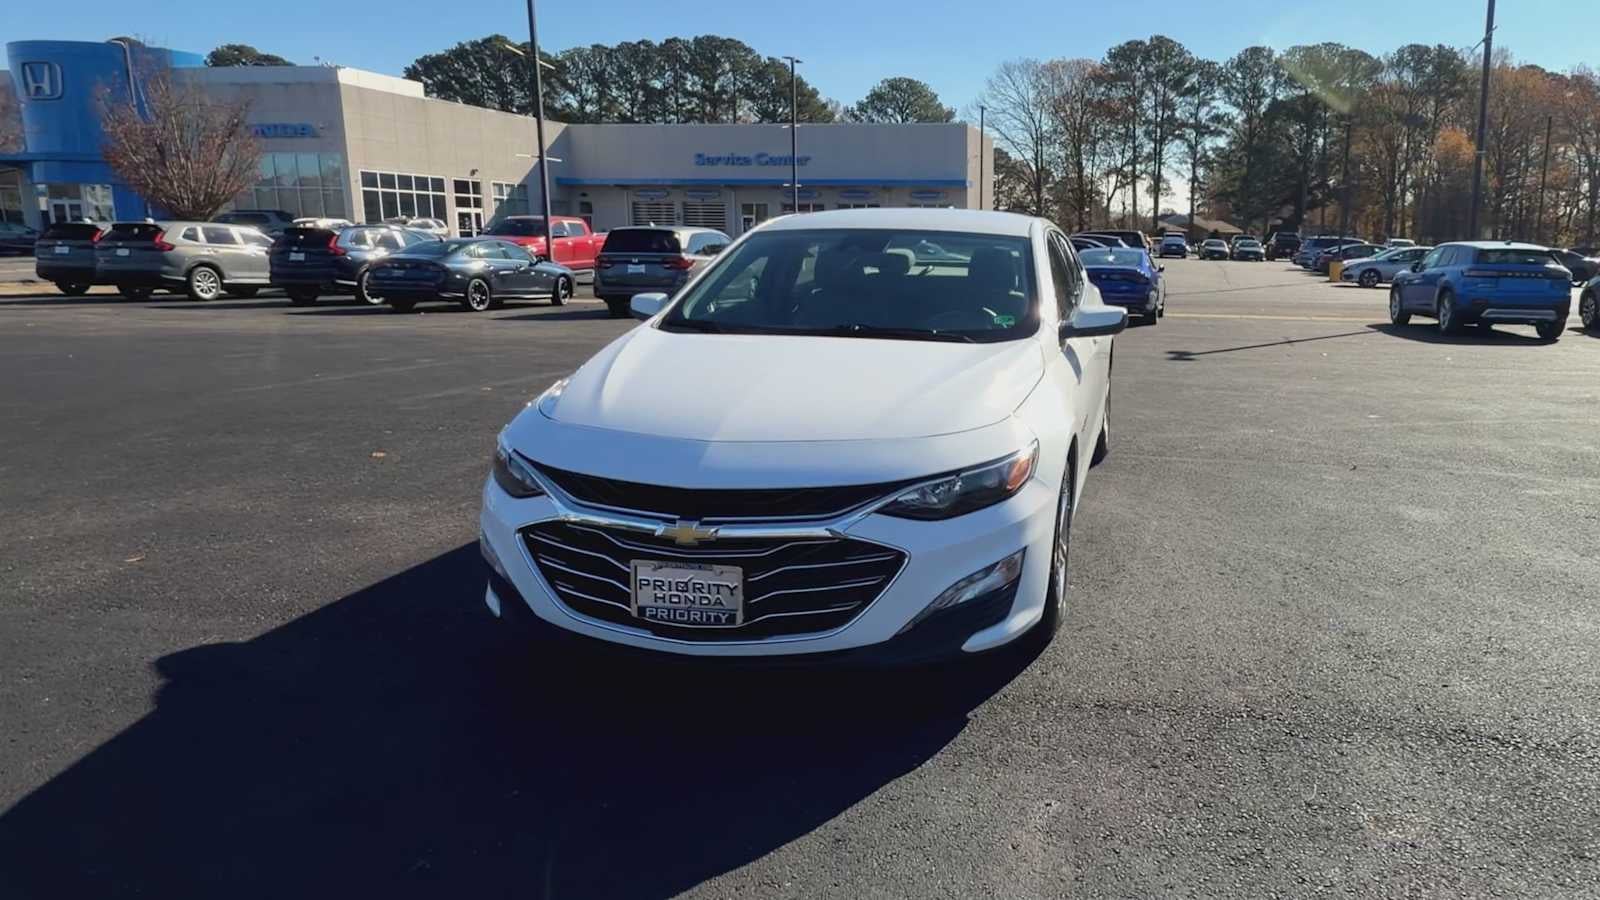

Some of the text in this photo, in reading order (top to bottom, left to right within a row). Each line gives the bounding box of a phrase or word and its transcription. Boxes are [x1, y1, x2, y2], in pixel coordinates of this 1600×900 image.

[694, 152, 753, 167] Service
[639, 575, 738, 597] PRIORITY
[654, 592, 726, 608] HONDA
[645, 607, 729, 624] PRIORITY
